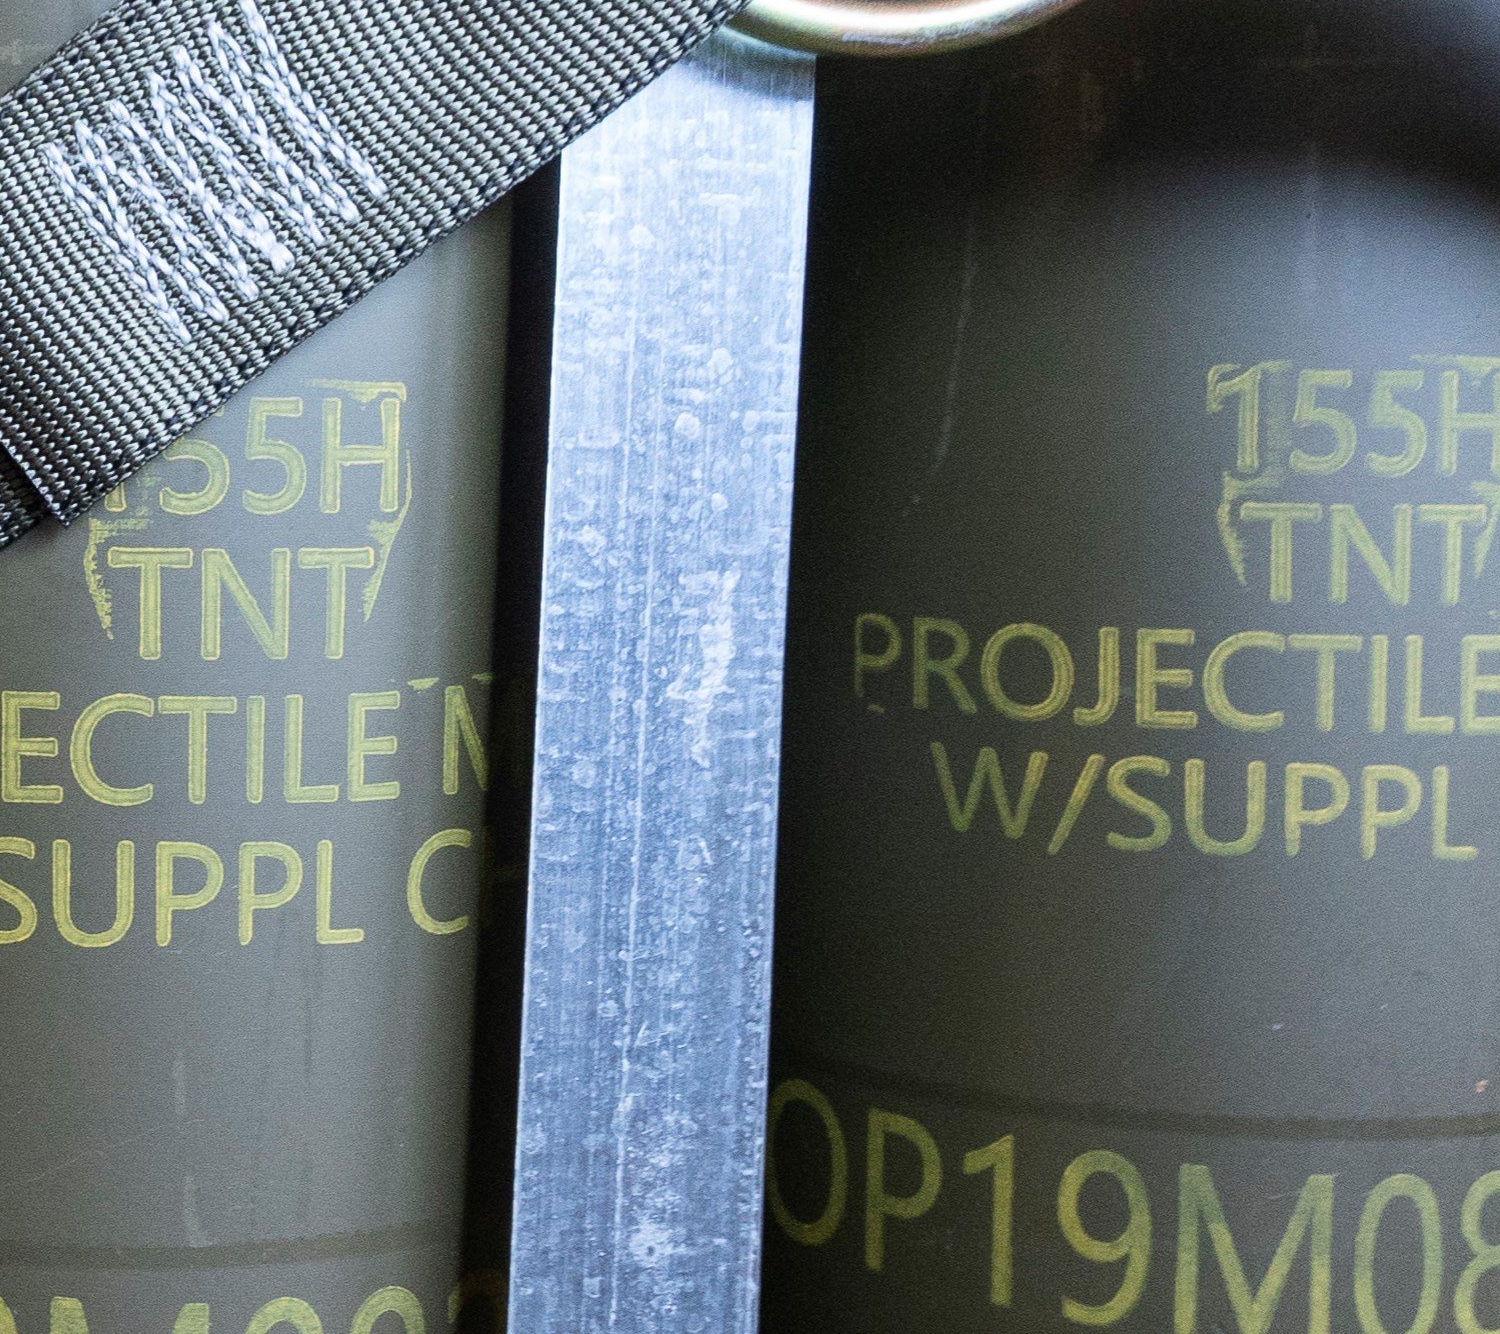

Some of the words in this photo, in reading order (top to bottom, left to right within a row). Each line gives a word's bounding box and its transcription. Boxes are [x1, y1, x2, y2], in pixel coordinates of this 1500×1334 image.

[106, 545, 375, 661] TNT
[1239, 501, 1488, 607] TNT
[930, 741, 1478, 862] W/SUPPL
